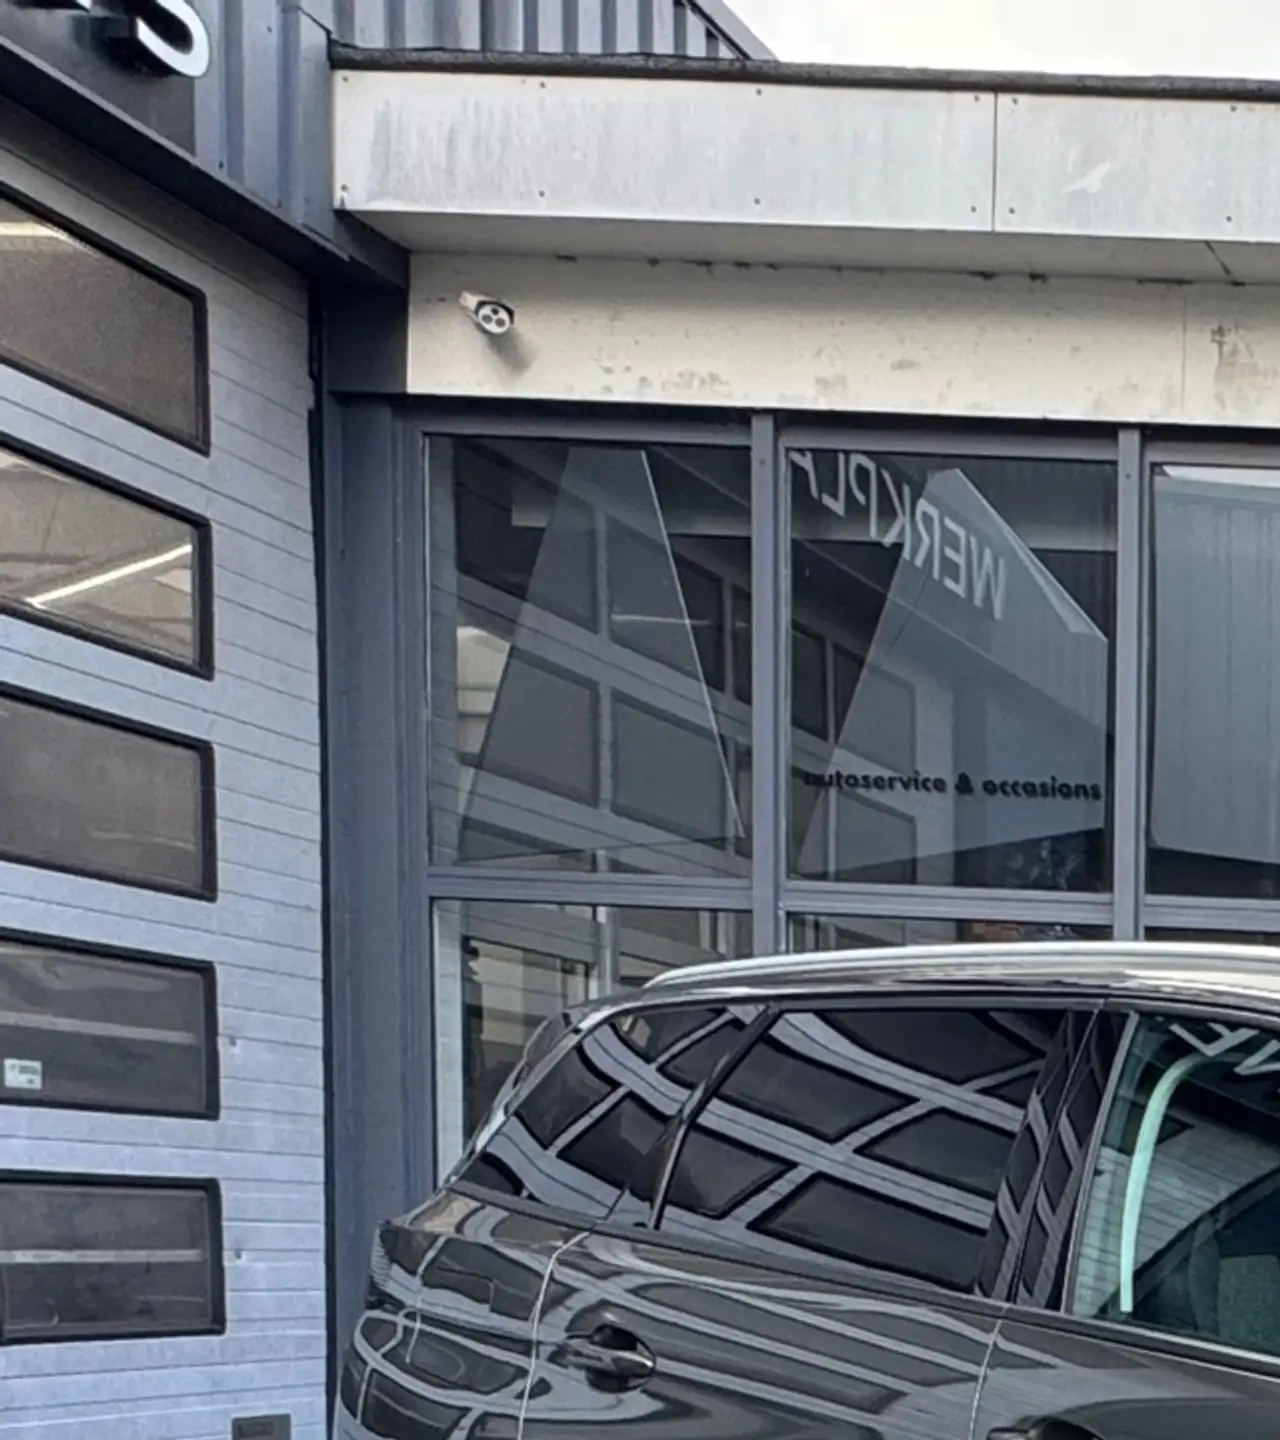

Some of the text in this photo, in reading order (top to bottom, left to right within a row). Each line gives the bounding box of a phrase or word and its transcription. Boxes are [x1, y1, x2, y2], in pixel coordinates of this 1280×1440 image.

[804, 769, 1103, 801] autoservice & occasions
